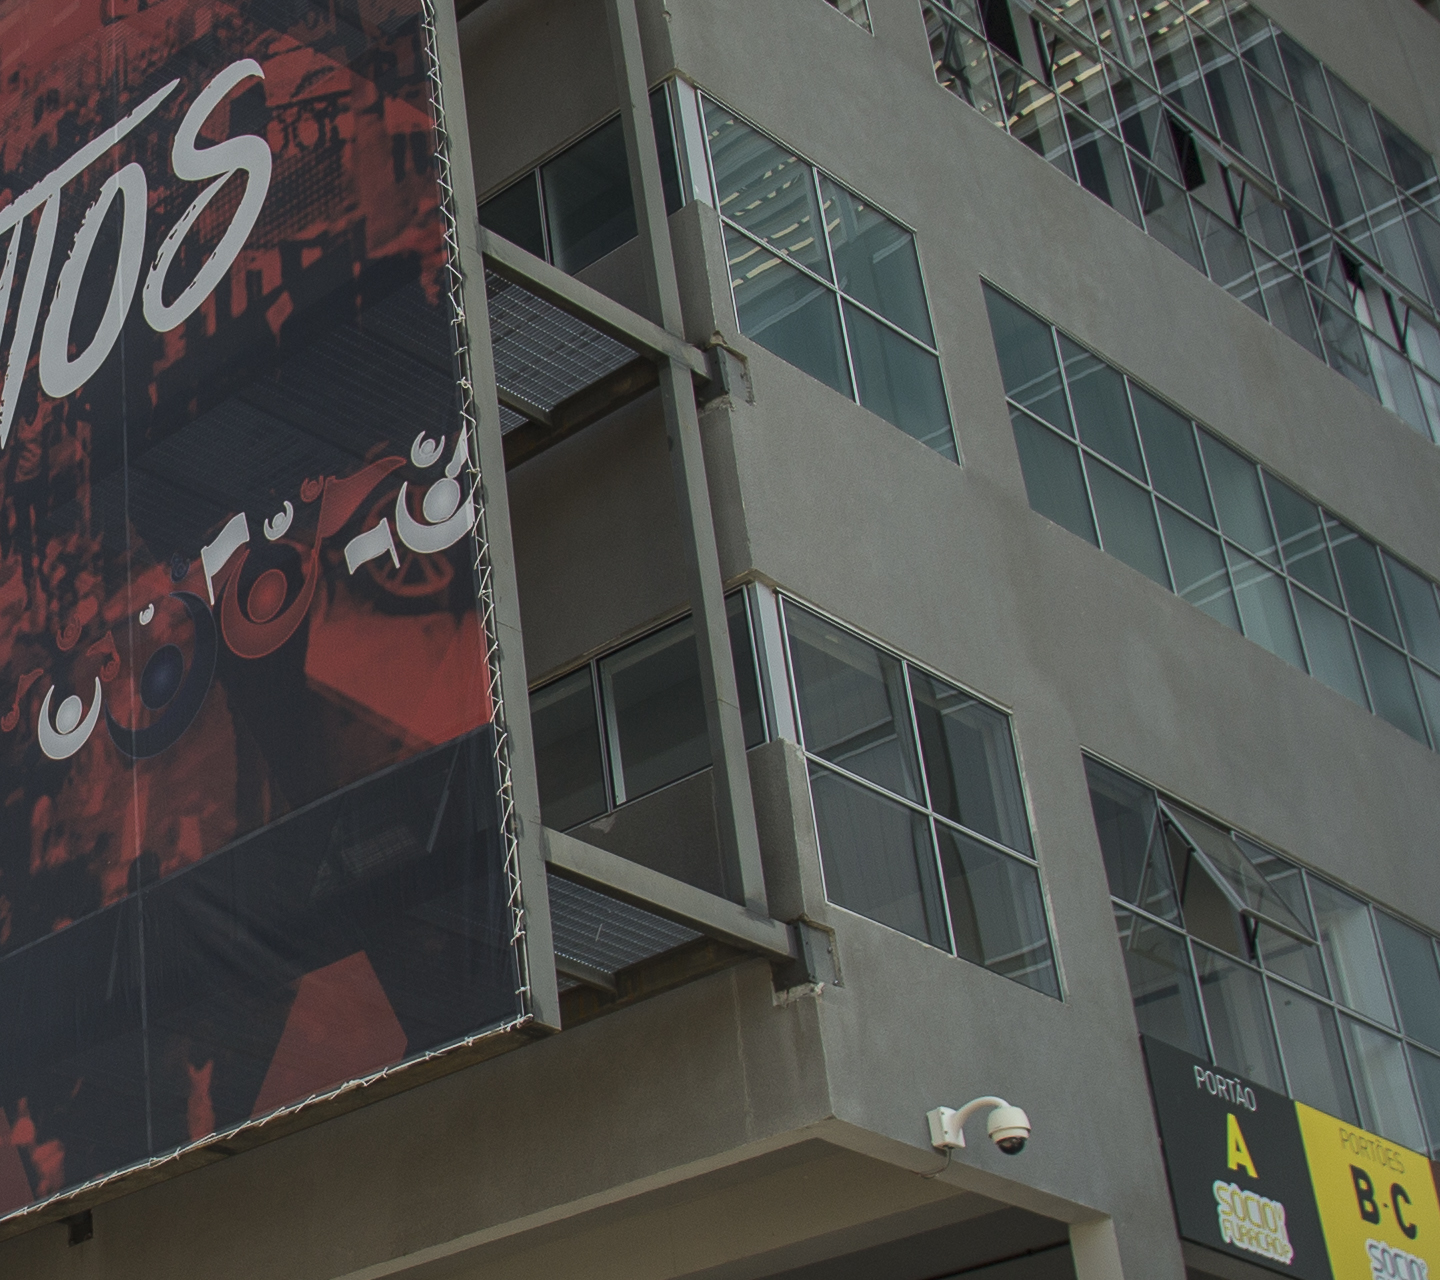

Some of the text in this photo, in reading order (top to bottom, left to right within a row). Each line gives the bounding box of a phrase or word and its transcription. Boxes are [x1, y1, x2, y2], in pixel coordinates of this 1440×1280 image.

[1194, 1065, 1257, 1111] PORTÃO
[1226, 1112, 1259, 1179] A
[1339, 1127, 1405, 1174] PORTÕES
